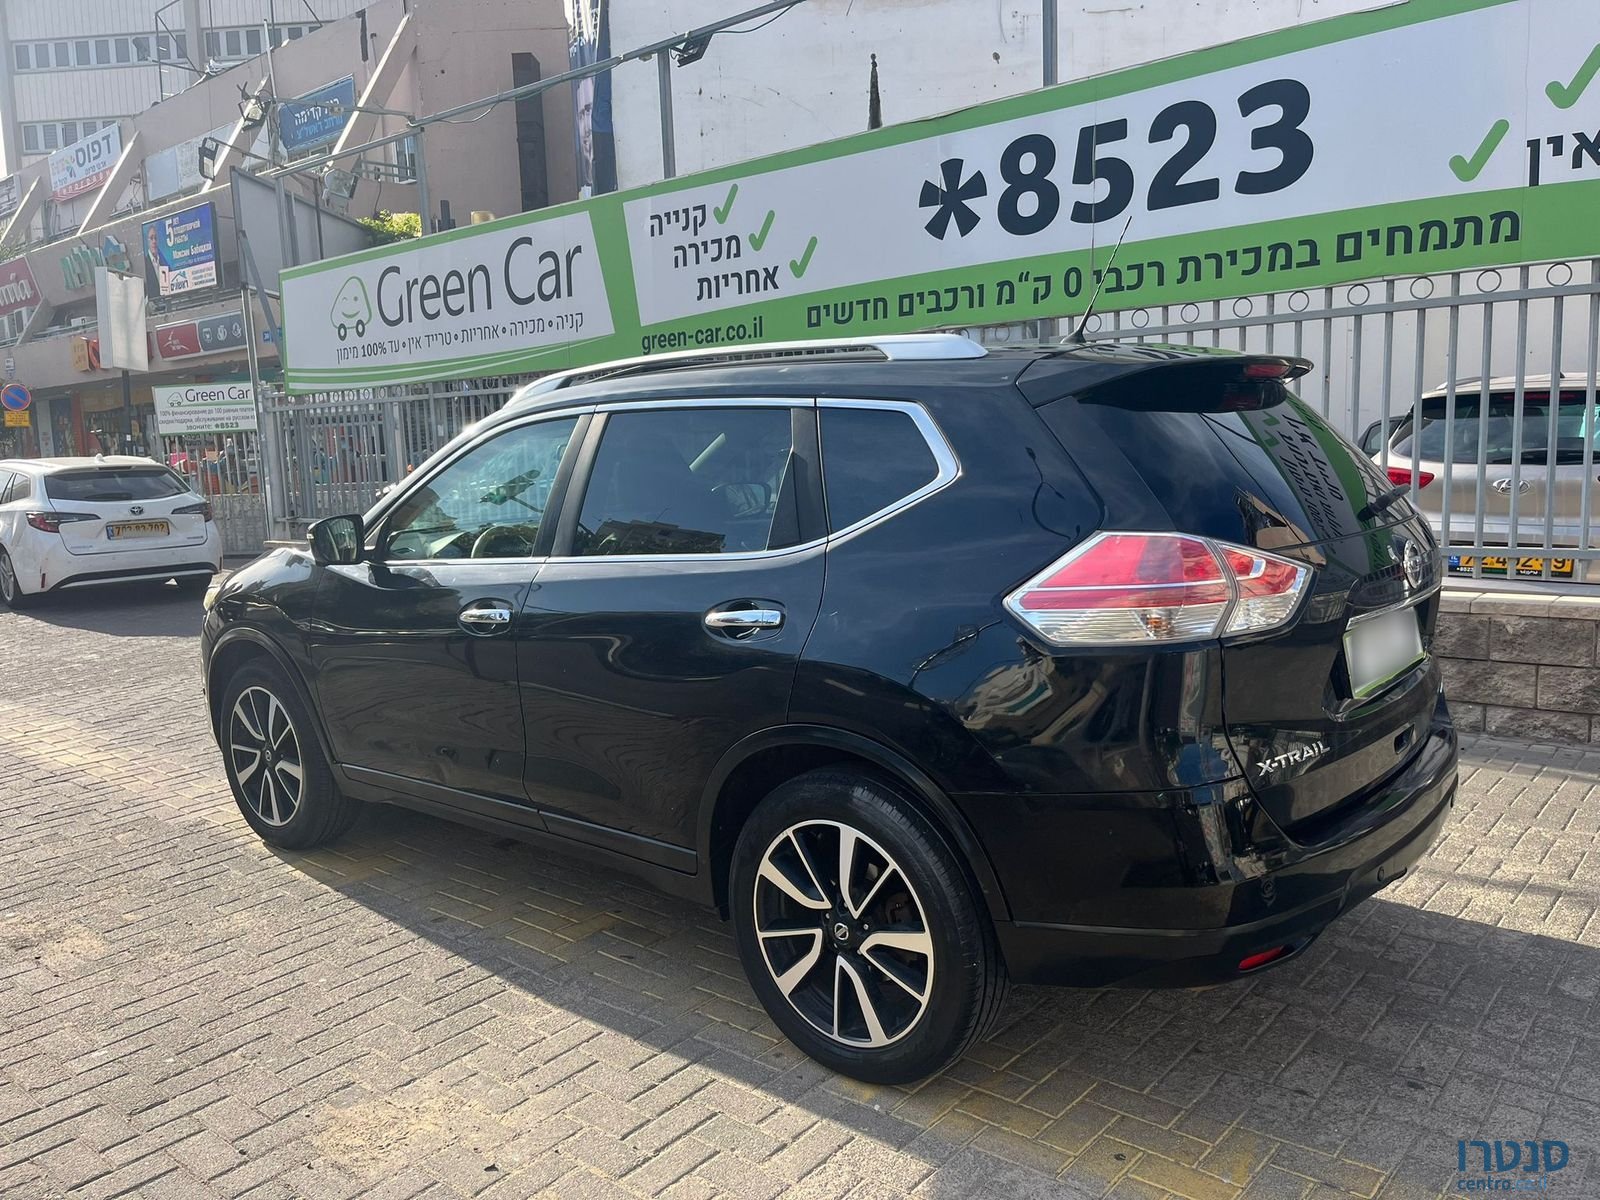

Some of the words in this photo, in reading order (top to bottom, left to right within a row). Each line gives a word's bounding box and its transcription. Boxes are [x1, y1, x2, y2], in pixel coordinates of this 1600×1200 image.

[75, 134, 111, 168] דפוס
[166, 218, 174, 247] 5
[650, 204, 707, 238] קנייה
[1335, 210, 1520, 263] מתמחים
[673, 234, 741, 269] מכירה
[1176, 238, 1321, 285] במכירת
[376, 263, 492, 327] Green
[504, 236, 582, 306] Car
[696, 265, 780, 301] אחריות
[1063, 266, 1083, 298] 0
[1093, 260, 1165, 294] רכבי
[807, 296, 889, 328] חדשים
[898, 283, 985, 317] ורכבים
[461, 323, 500, 344] אחריות
[509, 317, 545, 337] מכירה
[556, 312, 584, 333] קניה
[641, 315, 763, 355] green-car.co.il
[336, 346, 359, 364] מימון
[361, 341, 387, 358] 100%
[387, 339, 400, 353] עד
[407, 335, 423, 354] אין
[424, 331, 452, 347] טרייד
[185, 388, 225, 402] Green
[227, 386, 251, 400] Car
[1256, 740, 1331, 777] X-TRAIL
